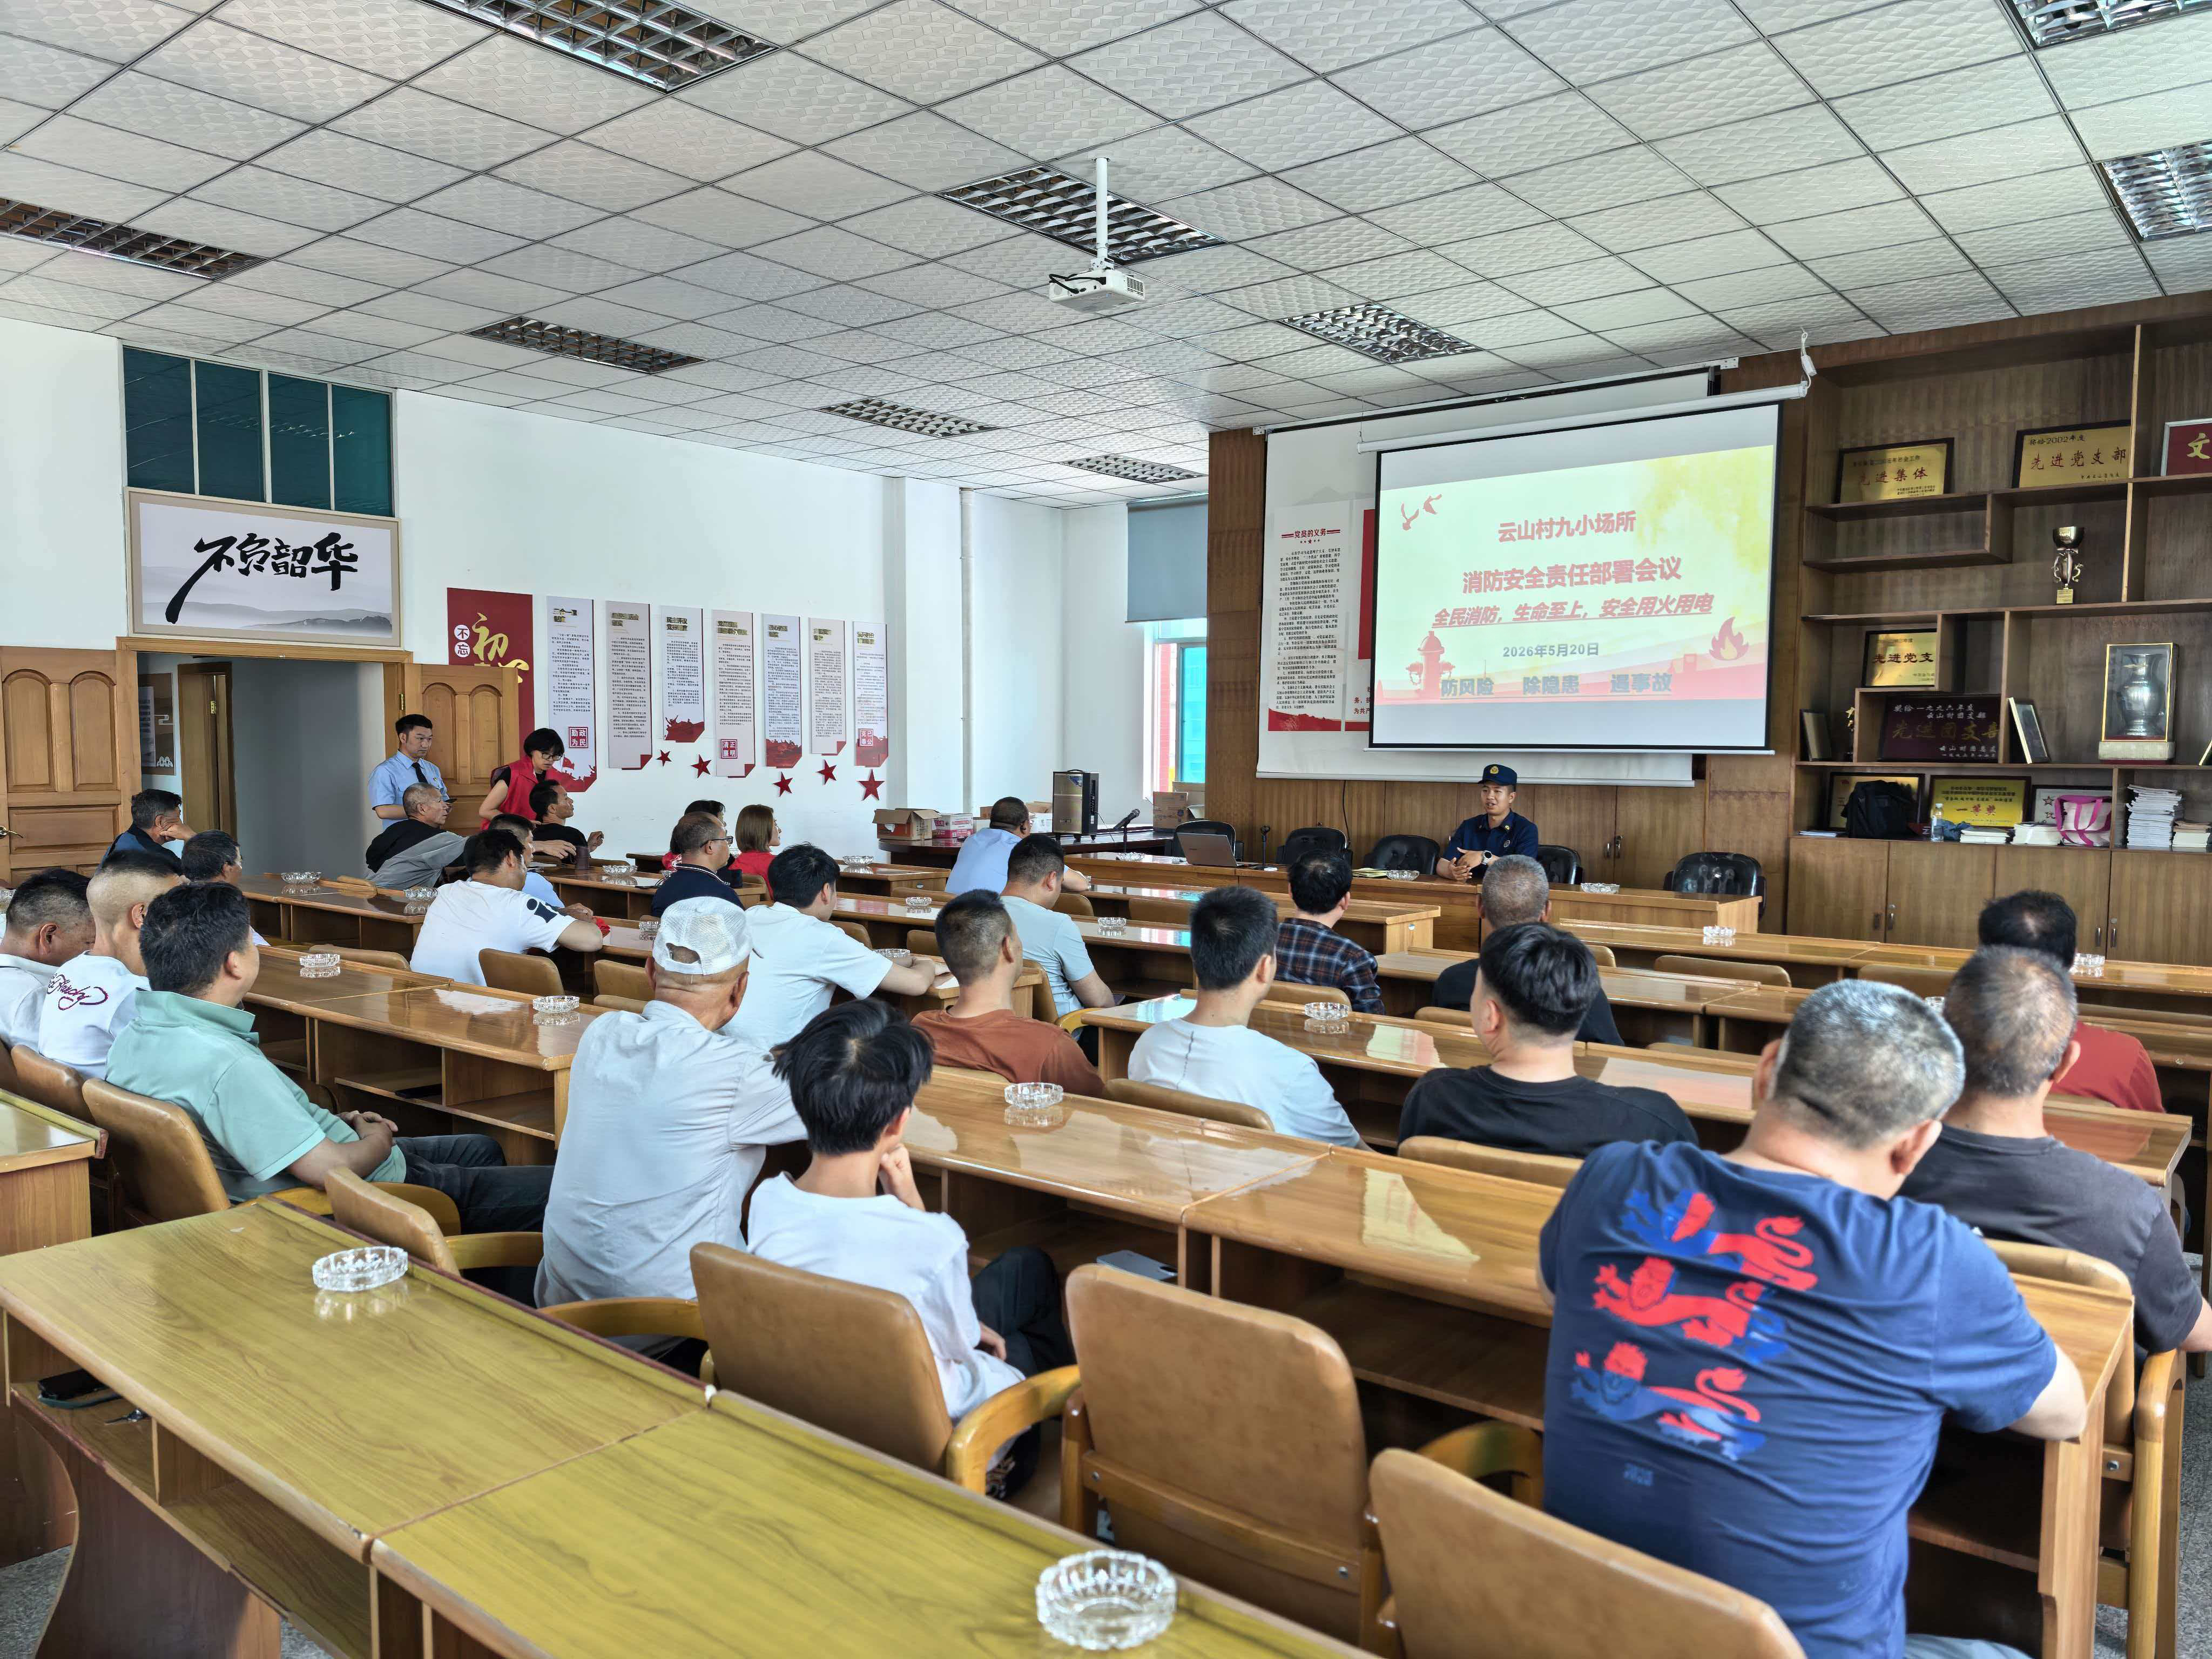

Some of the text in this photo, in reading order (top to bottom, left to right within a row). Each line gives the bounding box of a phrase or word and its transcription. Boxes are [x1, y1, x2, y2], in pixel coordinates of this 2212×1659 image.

[2031, 447, 2127, 470] 先进党支部
[2187, 432, 2211, 459] 文
[1861, 467, 1928, 485] 先进集体
[1294, 529, 1326, 538] 党员的义务
[1498, 510, 1636, 543] 云山村九小场所
[165, 532, 358, 624] 不负韶华
[1462, 556, 1682, 594] 消防安全责任部署会议
[1433, 594, 1714, 627] 全民消防，生命至上，安全用火用电
[457, 628, 468, 655] 不忘
[471, 612, 509, 662] 初
[1503, 643, 1600, 658] 2026年5月20日
[1441, 677, 1494, 696] 防风险
[1523, 675, 1580, 694] 除隐患
